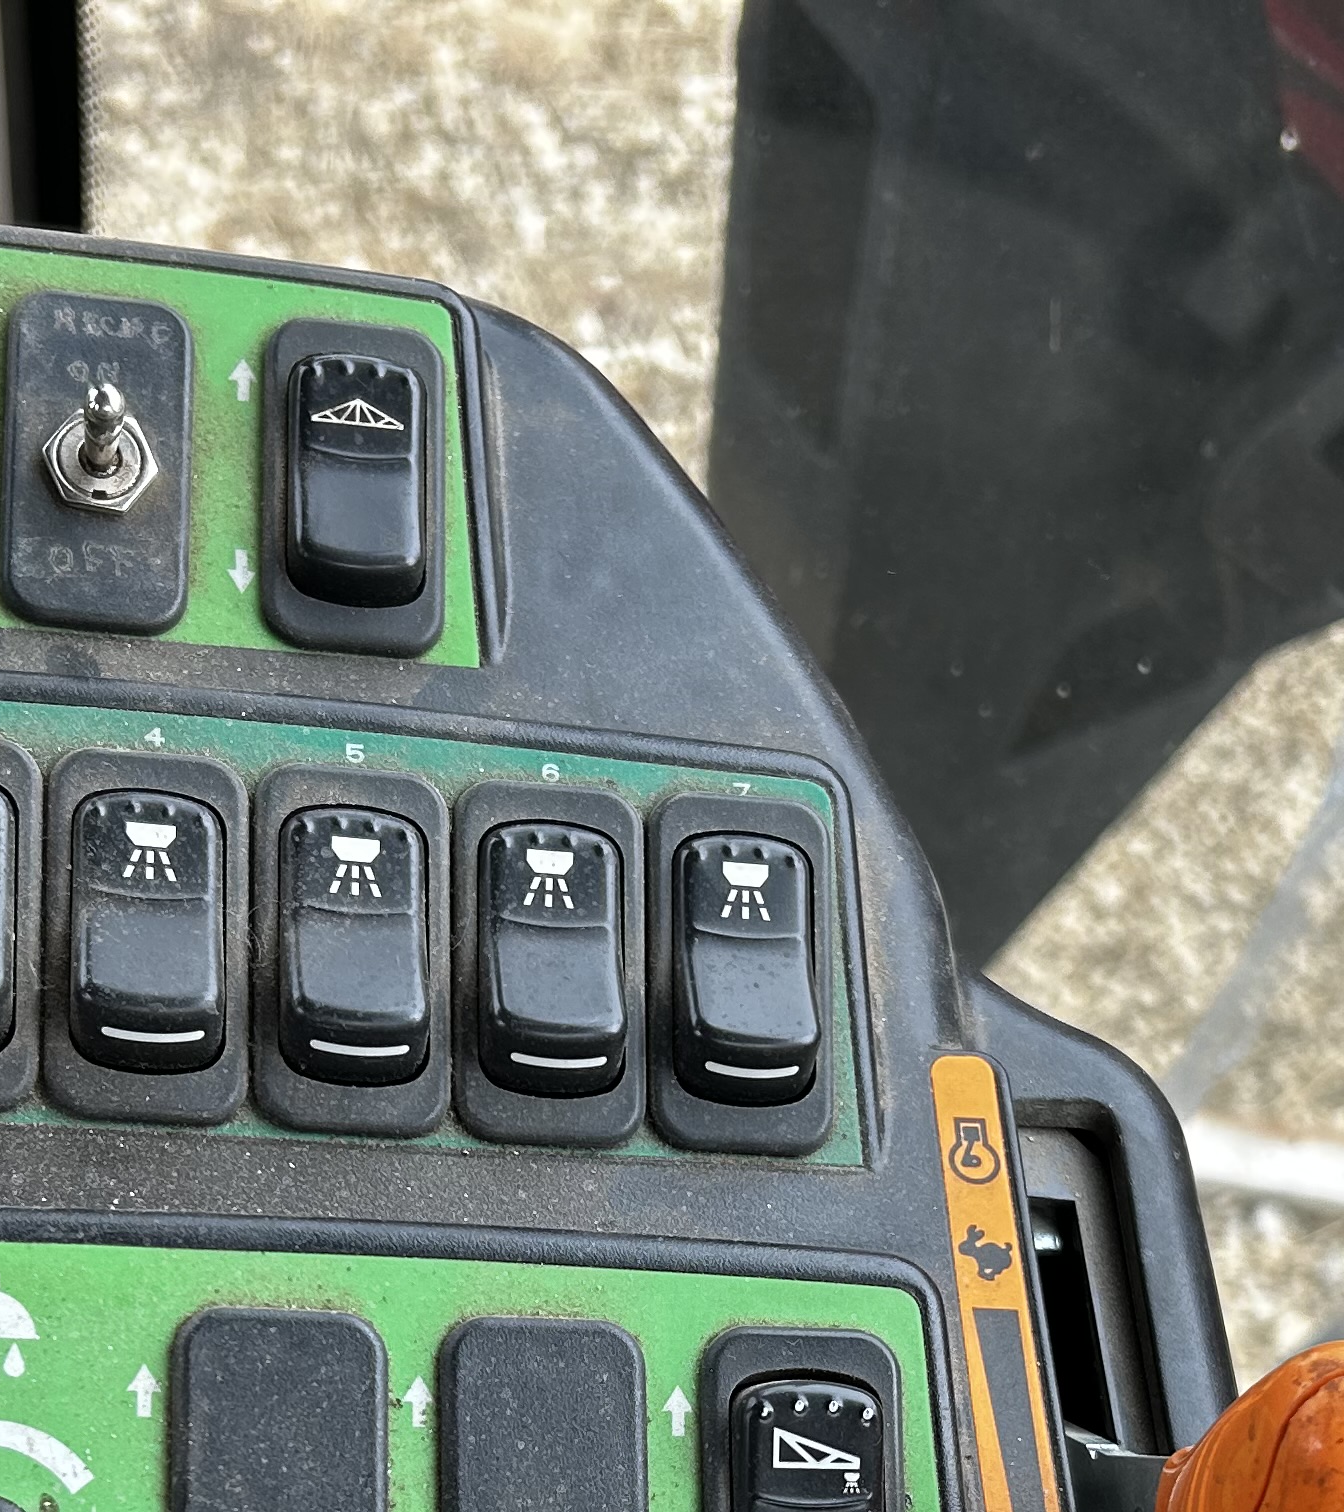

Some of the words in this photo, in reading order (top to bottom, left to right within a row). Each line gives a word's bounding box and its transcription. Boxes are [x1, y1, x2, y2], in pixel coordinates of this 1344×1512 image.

[49, 540, 135, 578] OFF
[144, 727, 164, 748] 4
[345, 743, 365, 764] 5
[541, 763, 560, 783] 6
[732, 782, 752, 797] 7
